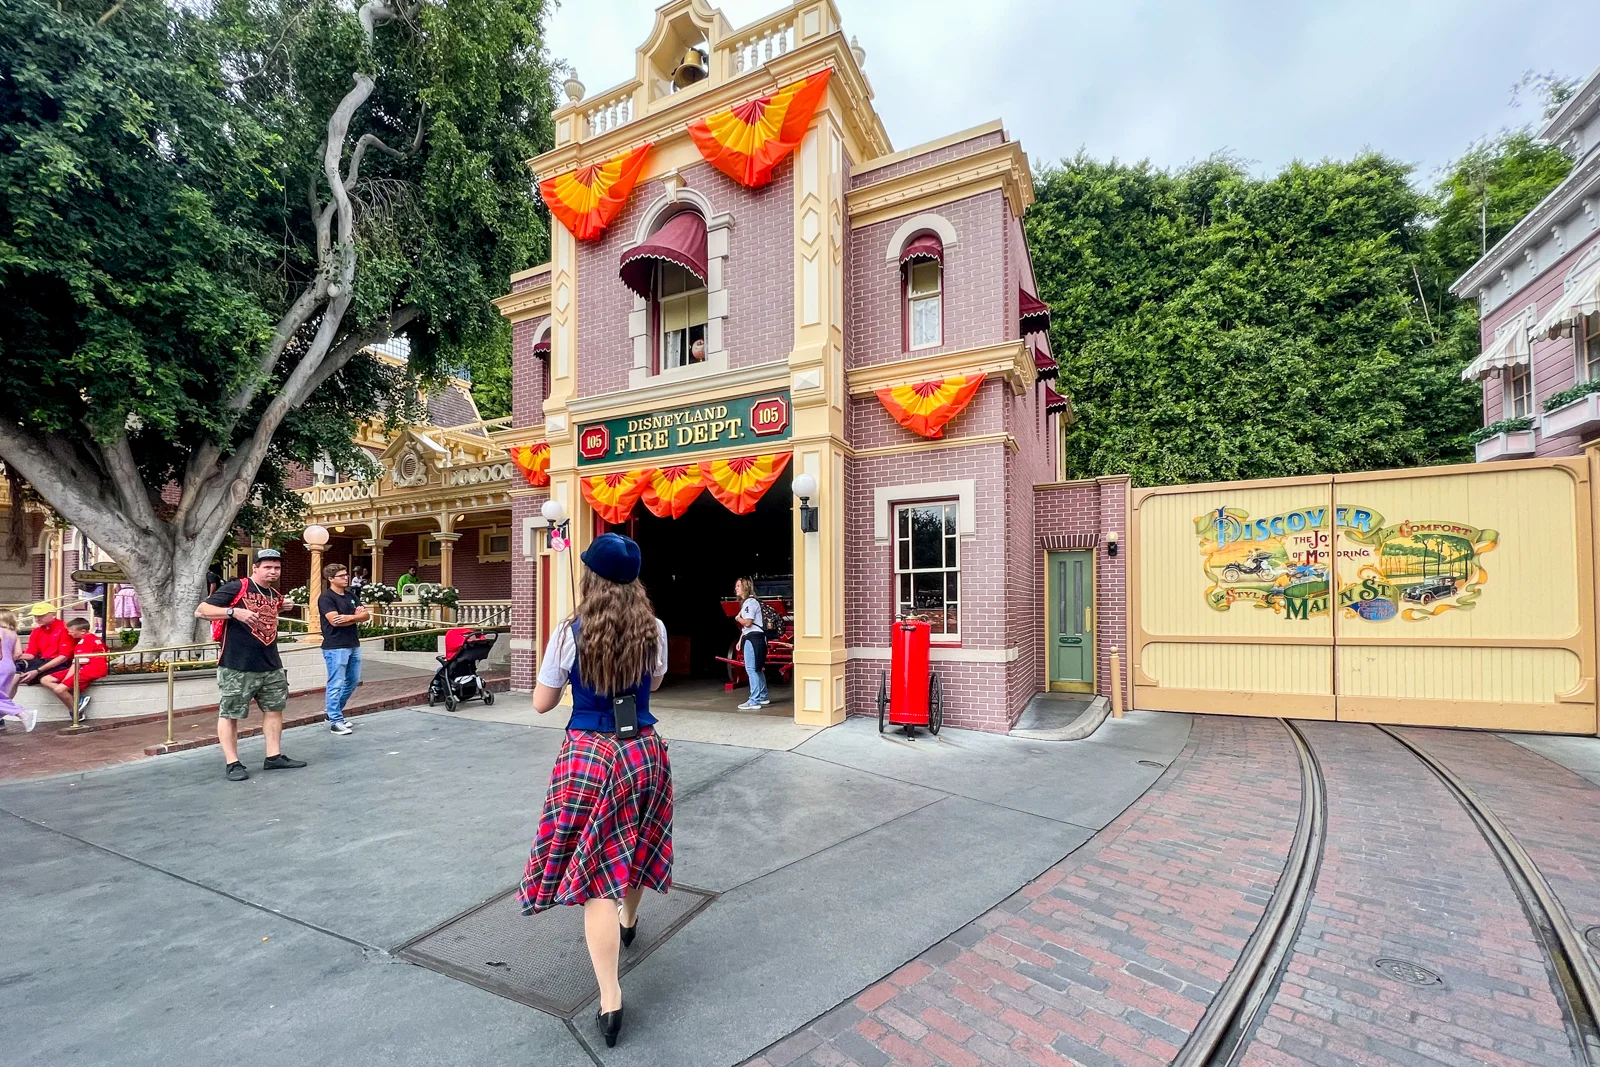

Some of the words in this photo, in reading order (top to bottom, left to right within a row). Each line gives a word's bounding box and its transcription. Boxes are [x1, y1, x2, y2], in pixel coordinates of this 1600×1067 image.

[628, 405, 728, 433] DISNEYLAND
[758, 407, 779, 424] 105
[586, 434, 602, 450] 105
[615, 428, 669, 455] FIRE
[676, 418, 745, 446] DEPT.
[1213, 505, 1372, 549] DISCOVER
[1399, 519, 1472, 538] COMFORT
[1293, 536, 1312, 545] THE
[1292, 551, 1304, 562] OF
[1303, 548, 1370, 566] MOTORING
[1284, 589, 1353, 621] MAIN
